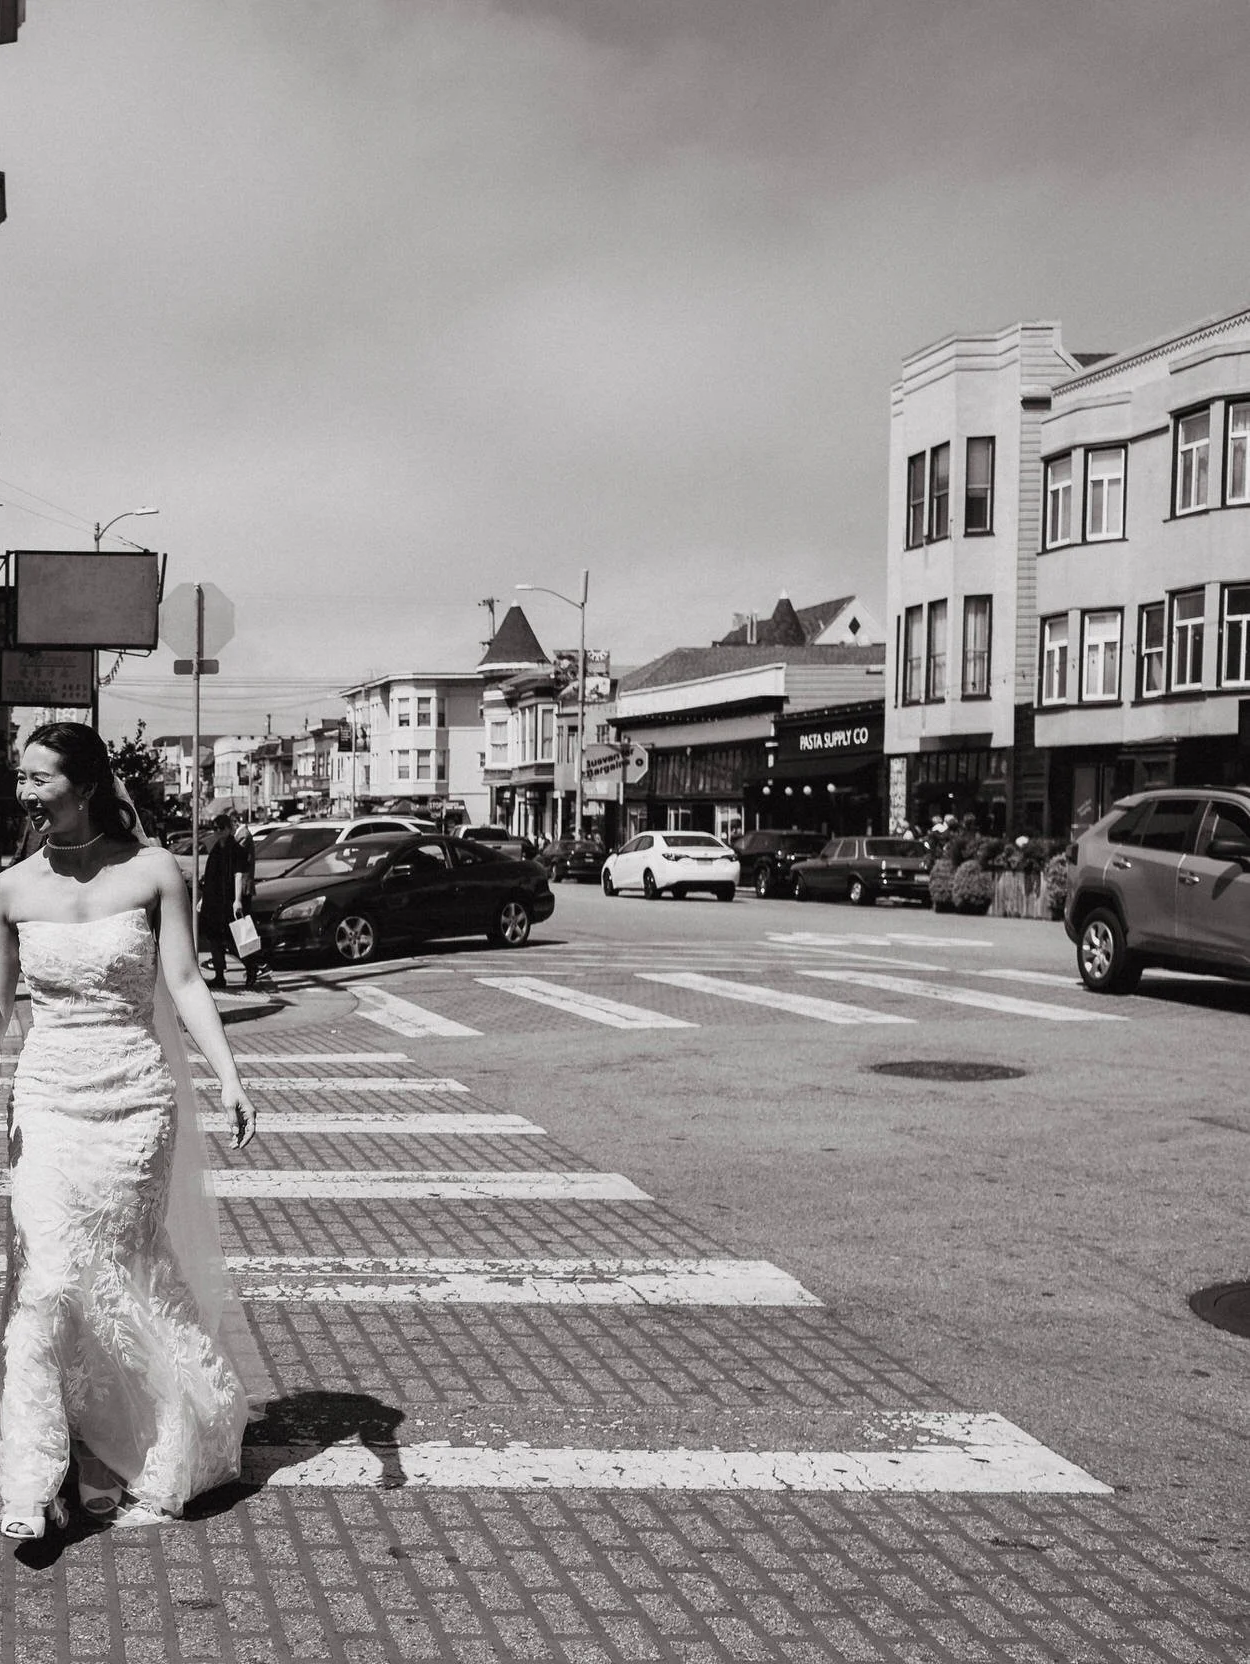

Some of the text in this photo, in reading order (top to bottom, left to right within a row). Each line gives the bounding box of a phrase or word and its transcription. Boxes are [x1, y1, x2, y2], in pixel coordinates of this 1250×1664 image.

[799, 727, 869, 751] PASTA SUPPLY CO
